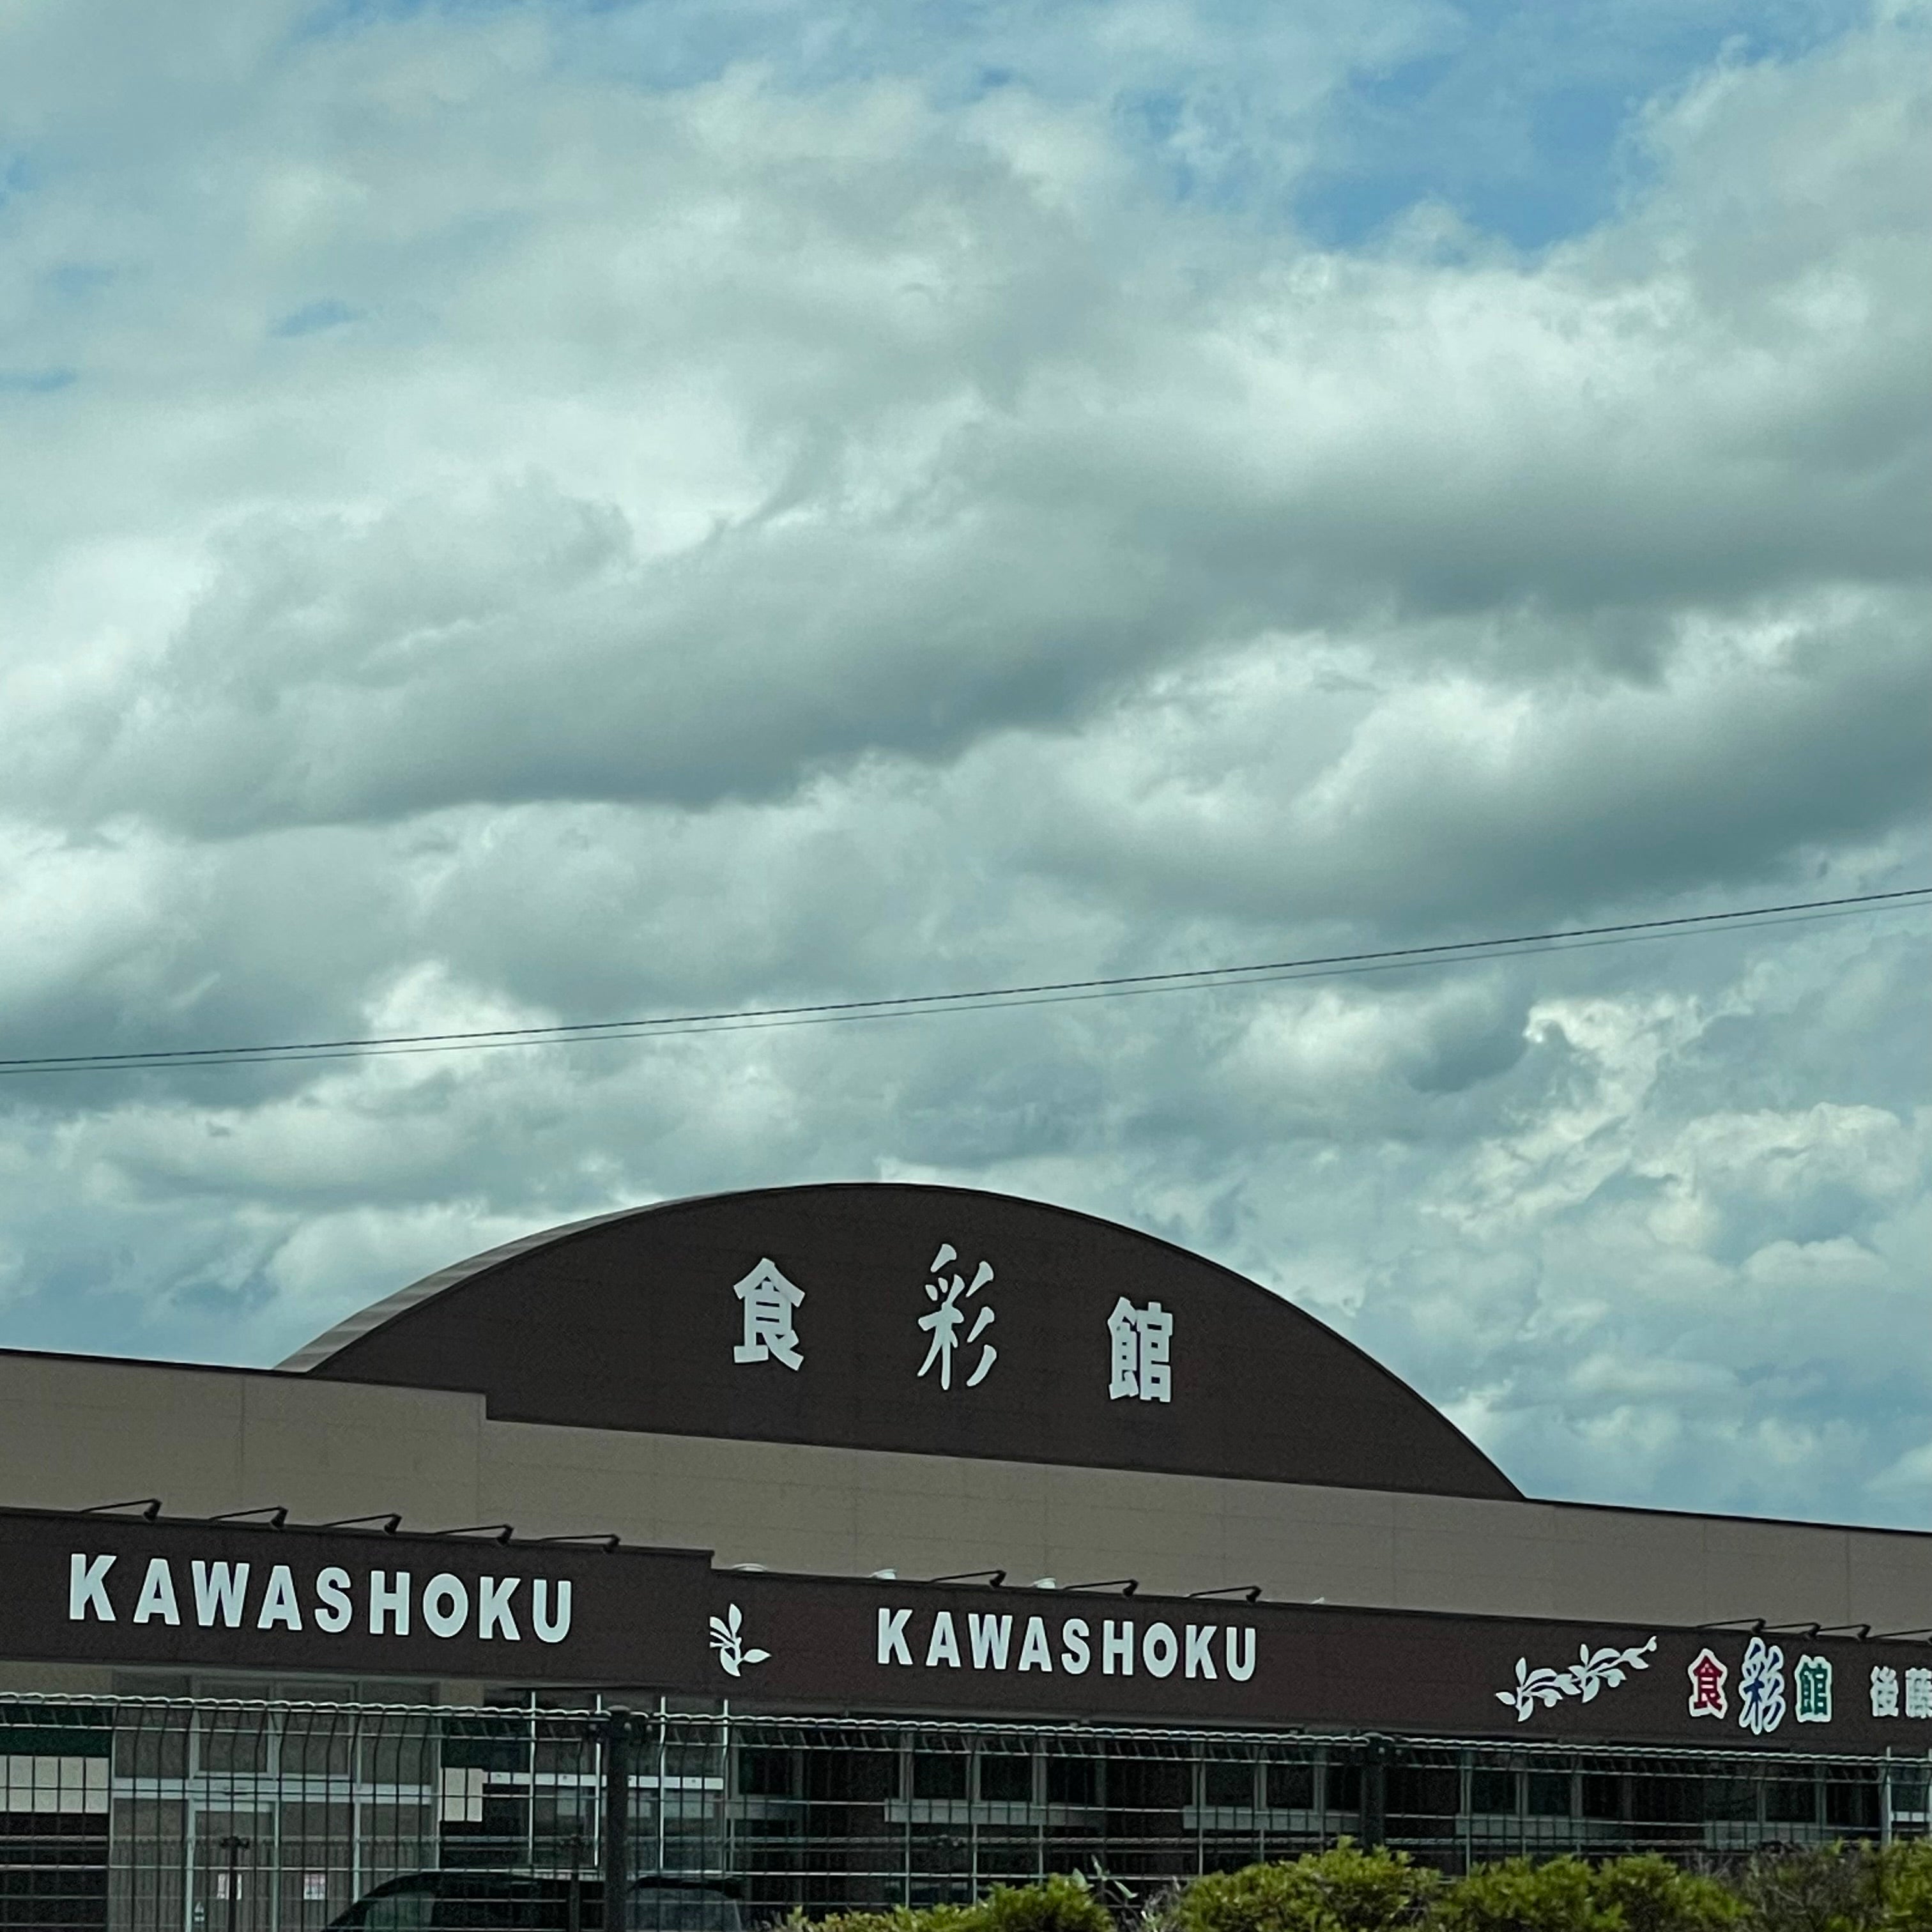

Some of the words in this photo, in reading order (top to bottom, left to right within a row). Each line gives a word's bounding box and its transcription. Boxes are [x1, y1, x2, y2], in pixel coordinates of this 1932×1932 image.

[733, 1243, 1173, 1403] 食彩館
[68, 1553, 572, 1643] KAWASHOKU
[877, 1607, 1257, 1682] KAWASHOKU
[1687, 1637, 1832, 1735] 食彩館
